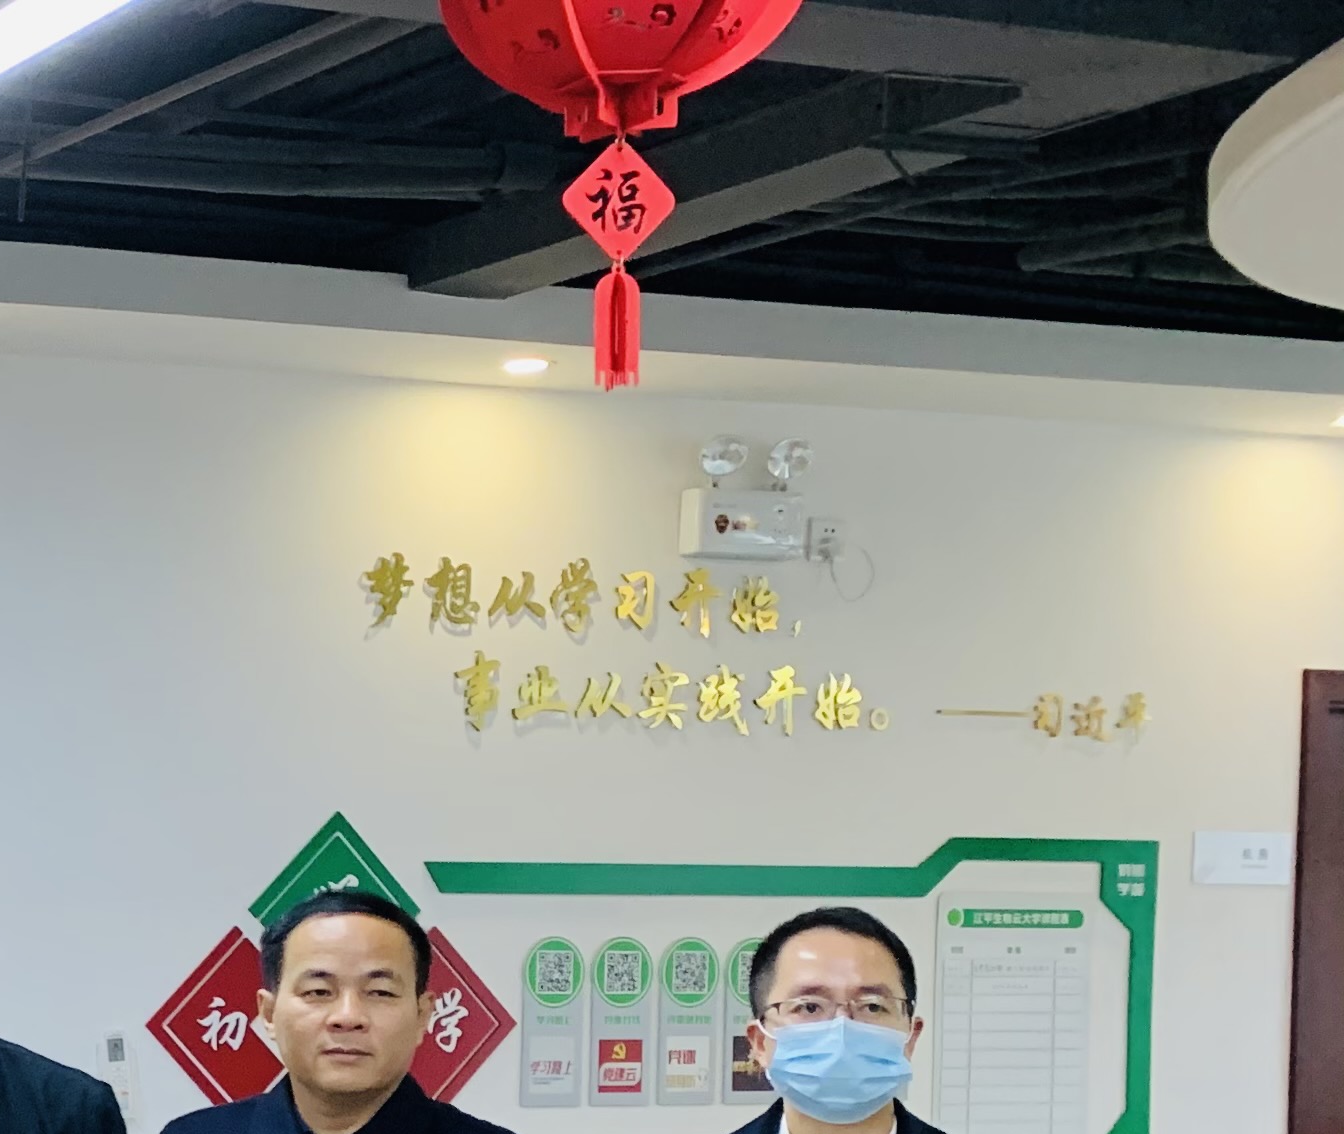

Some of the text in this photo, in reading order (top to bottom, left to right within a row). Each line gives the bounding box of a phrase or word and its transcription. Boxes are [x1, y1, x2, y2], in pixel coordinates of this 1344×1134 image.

[585, 168, 647, 235] 福
[196, 996, 249, 1051] 初
[427, 987, 469, 1053] 学
